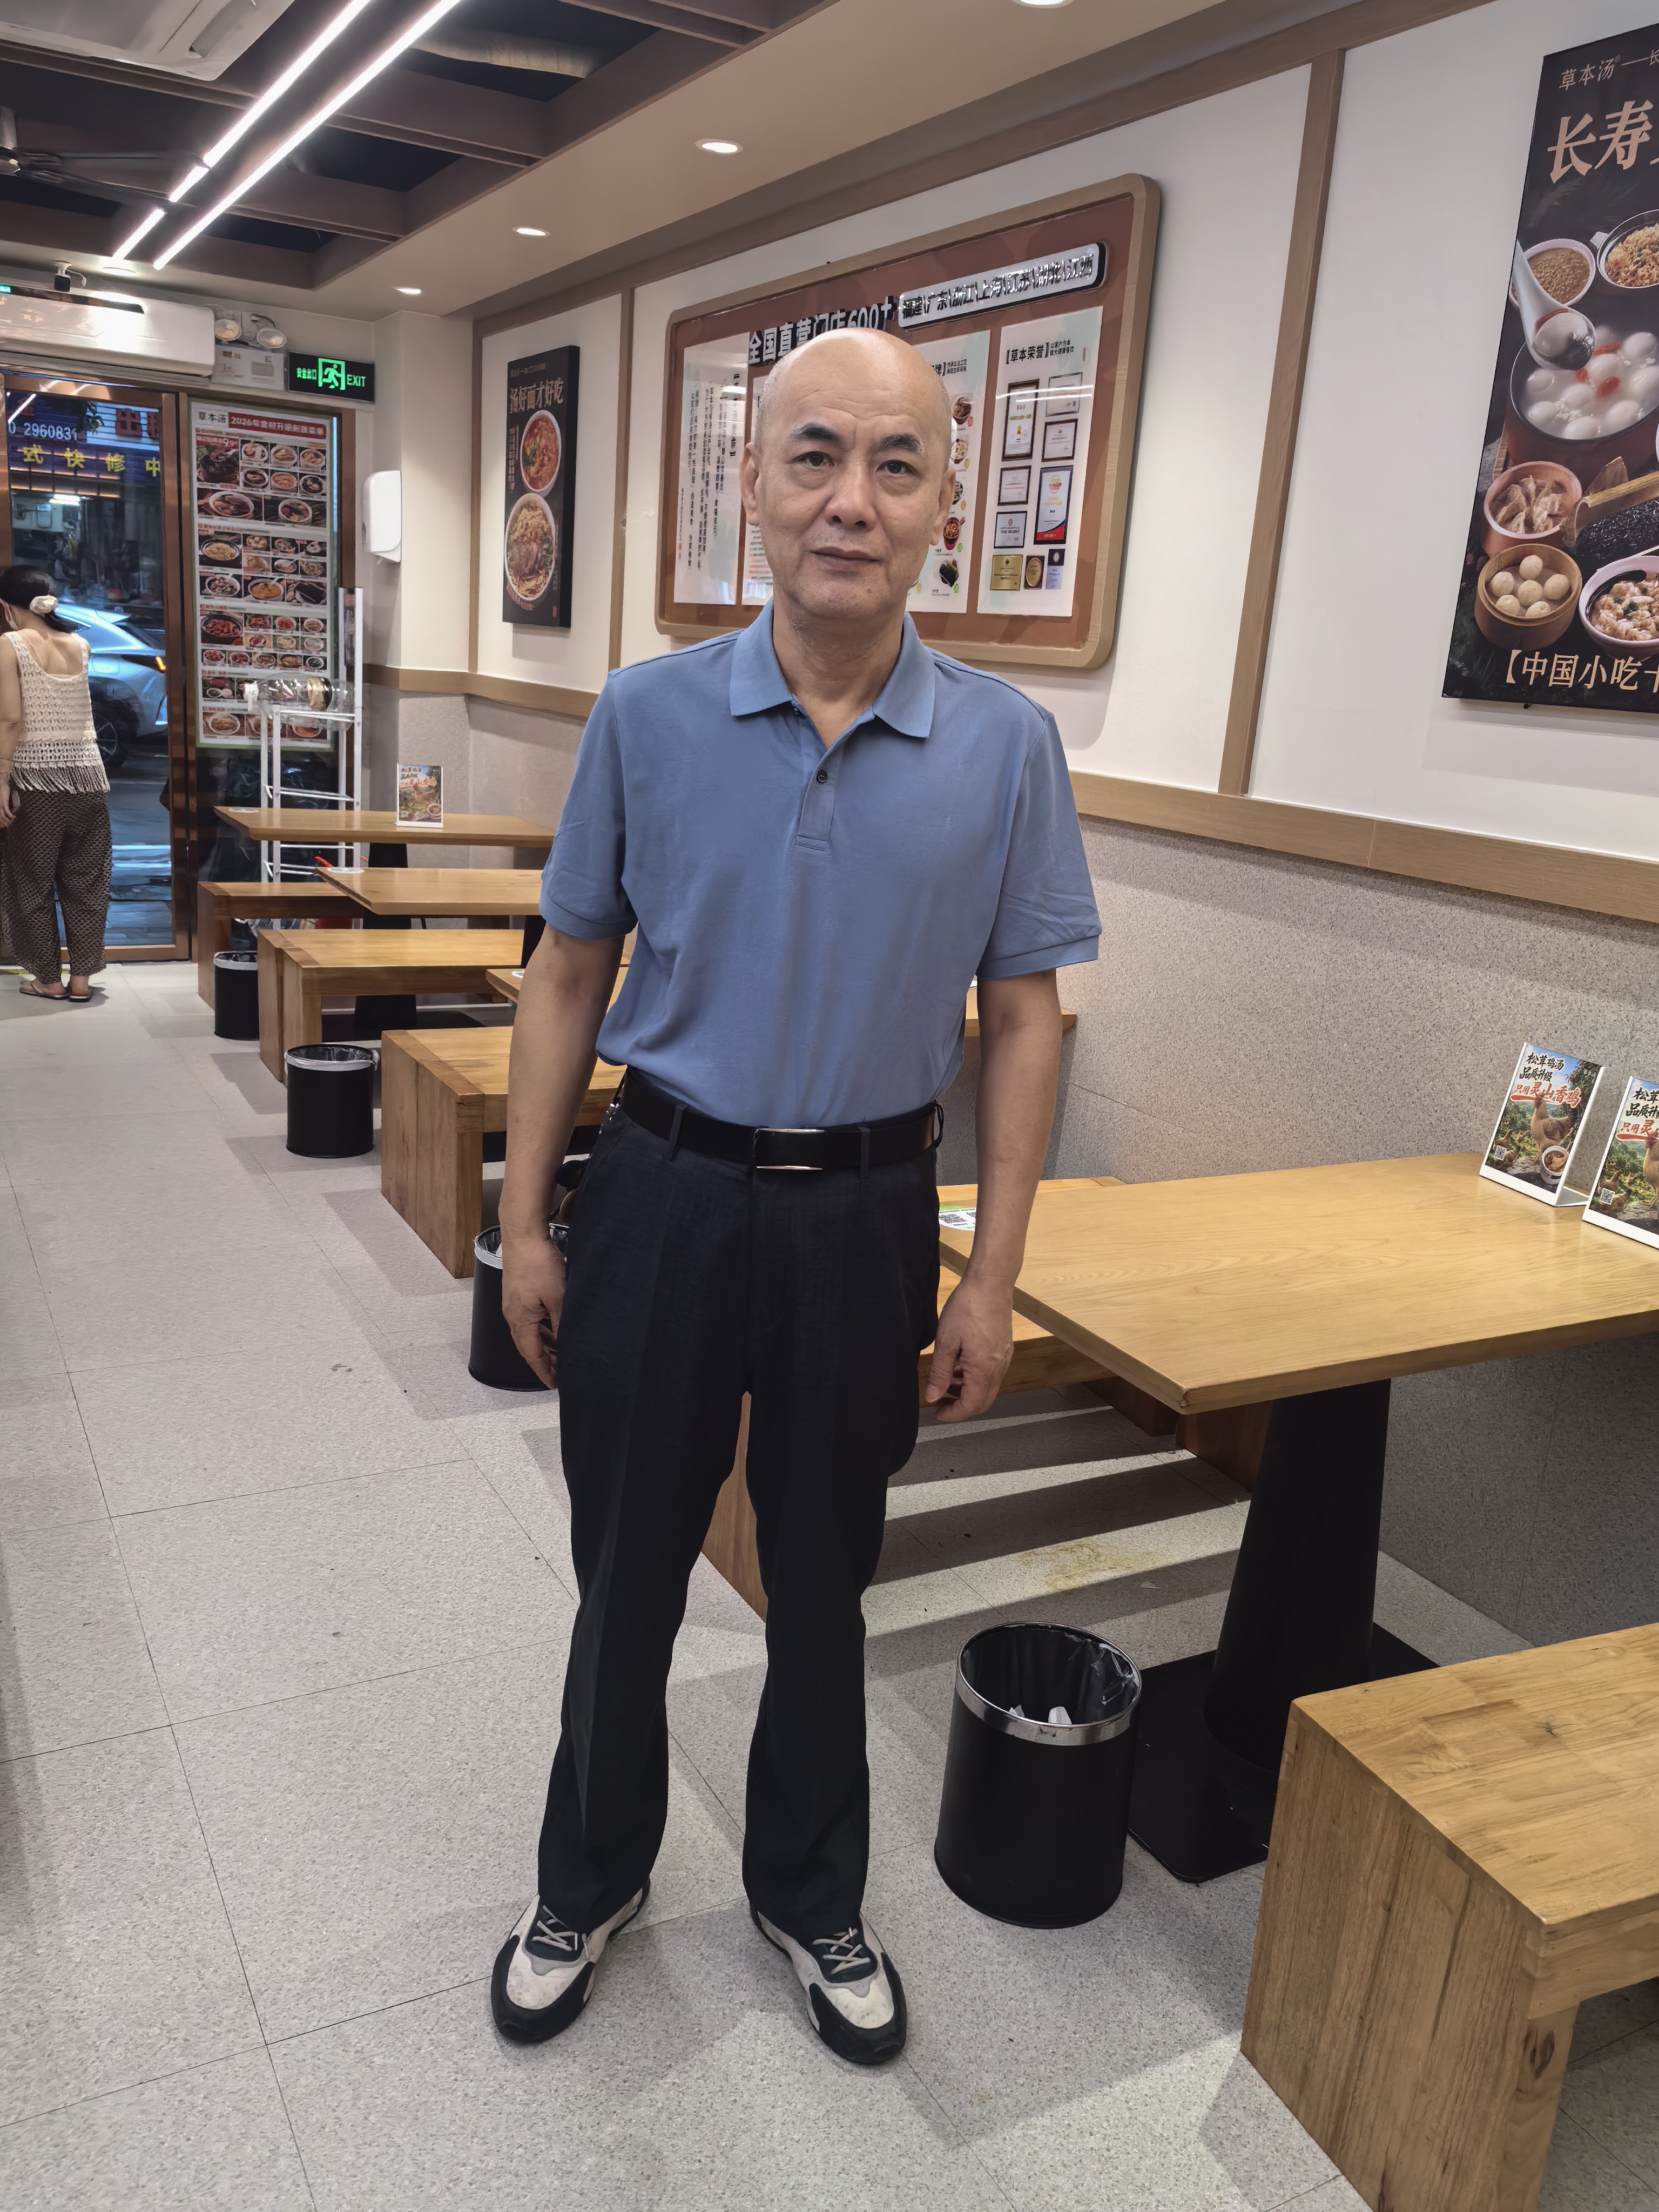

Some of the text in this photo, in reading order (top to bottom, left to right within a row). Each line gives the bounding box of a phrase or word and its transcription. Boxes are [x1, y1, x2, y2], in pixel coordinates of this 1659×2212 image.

[1547, 100, 1659, 184] 长寿
[347, 374, 366, 387] EXIT
[1527, 1052, 1564, 1071] 松茸鸡汤
[1519, 1067, 1553, 1082] 品质升级
[1514, 1081, 1582, 1107] 只用灵山香鸡
